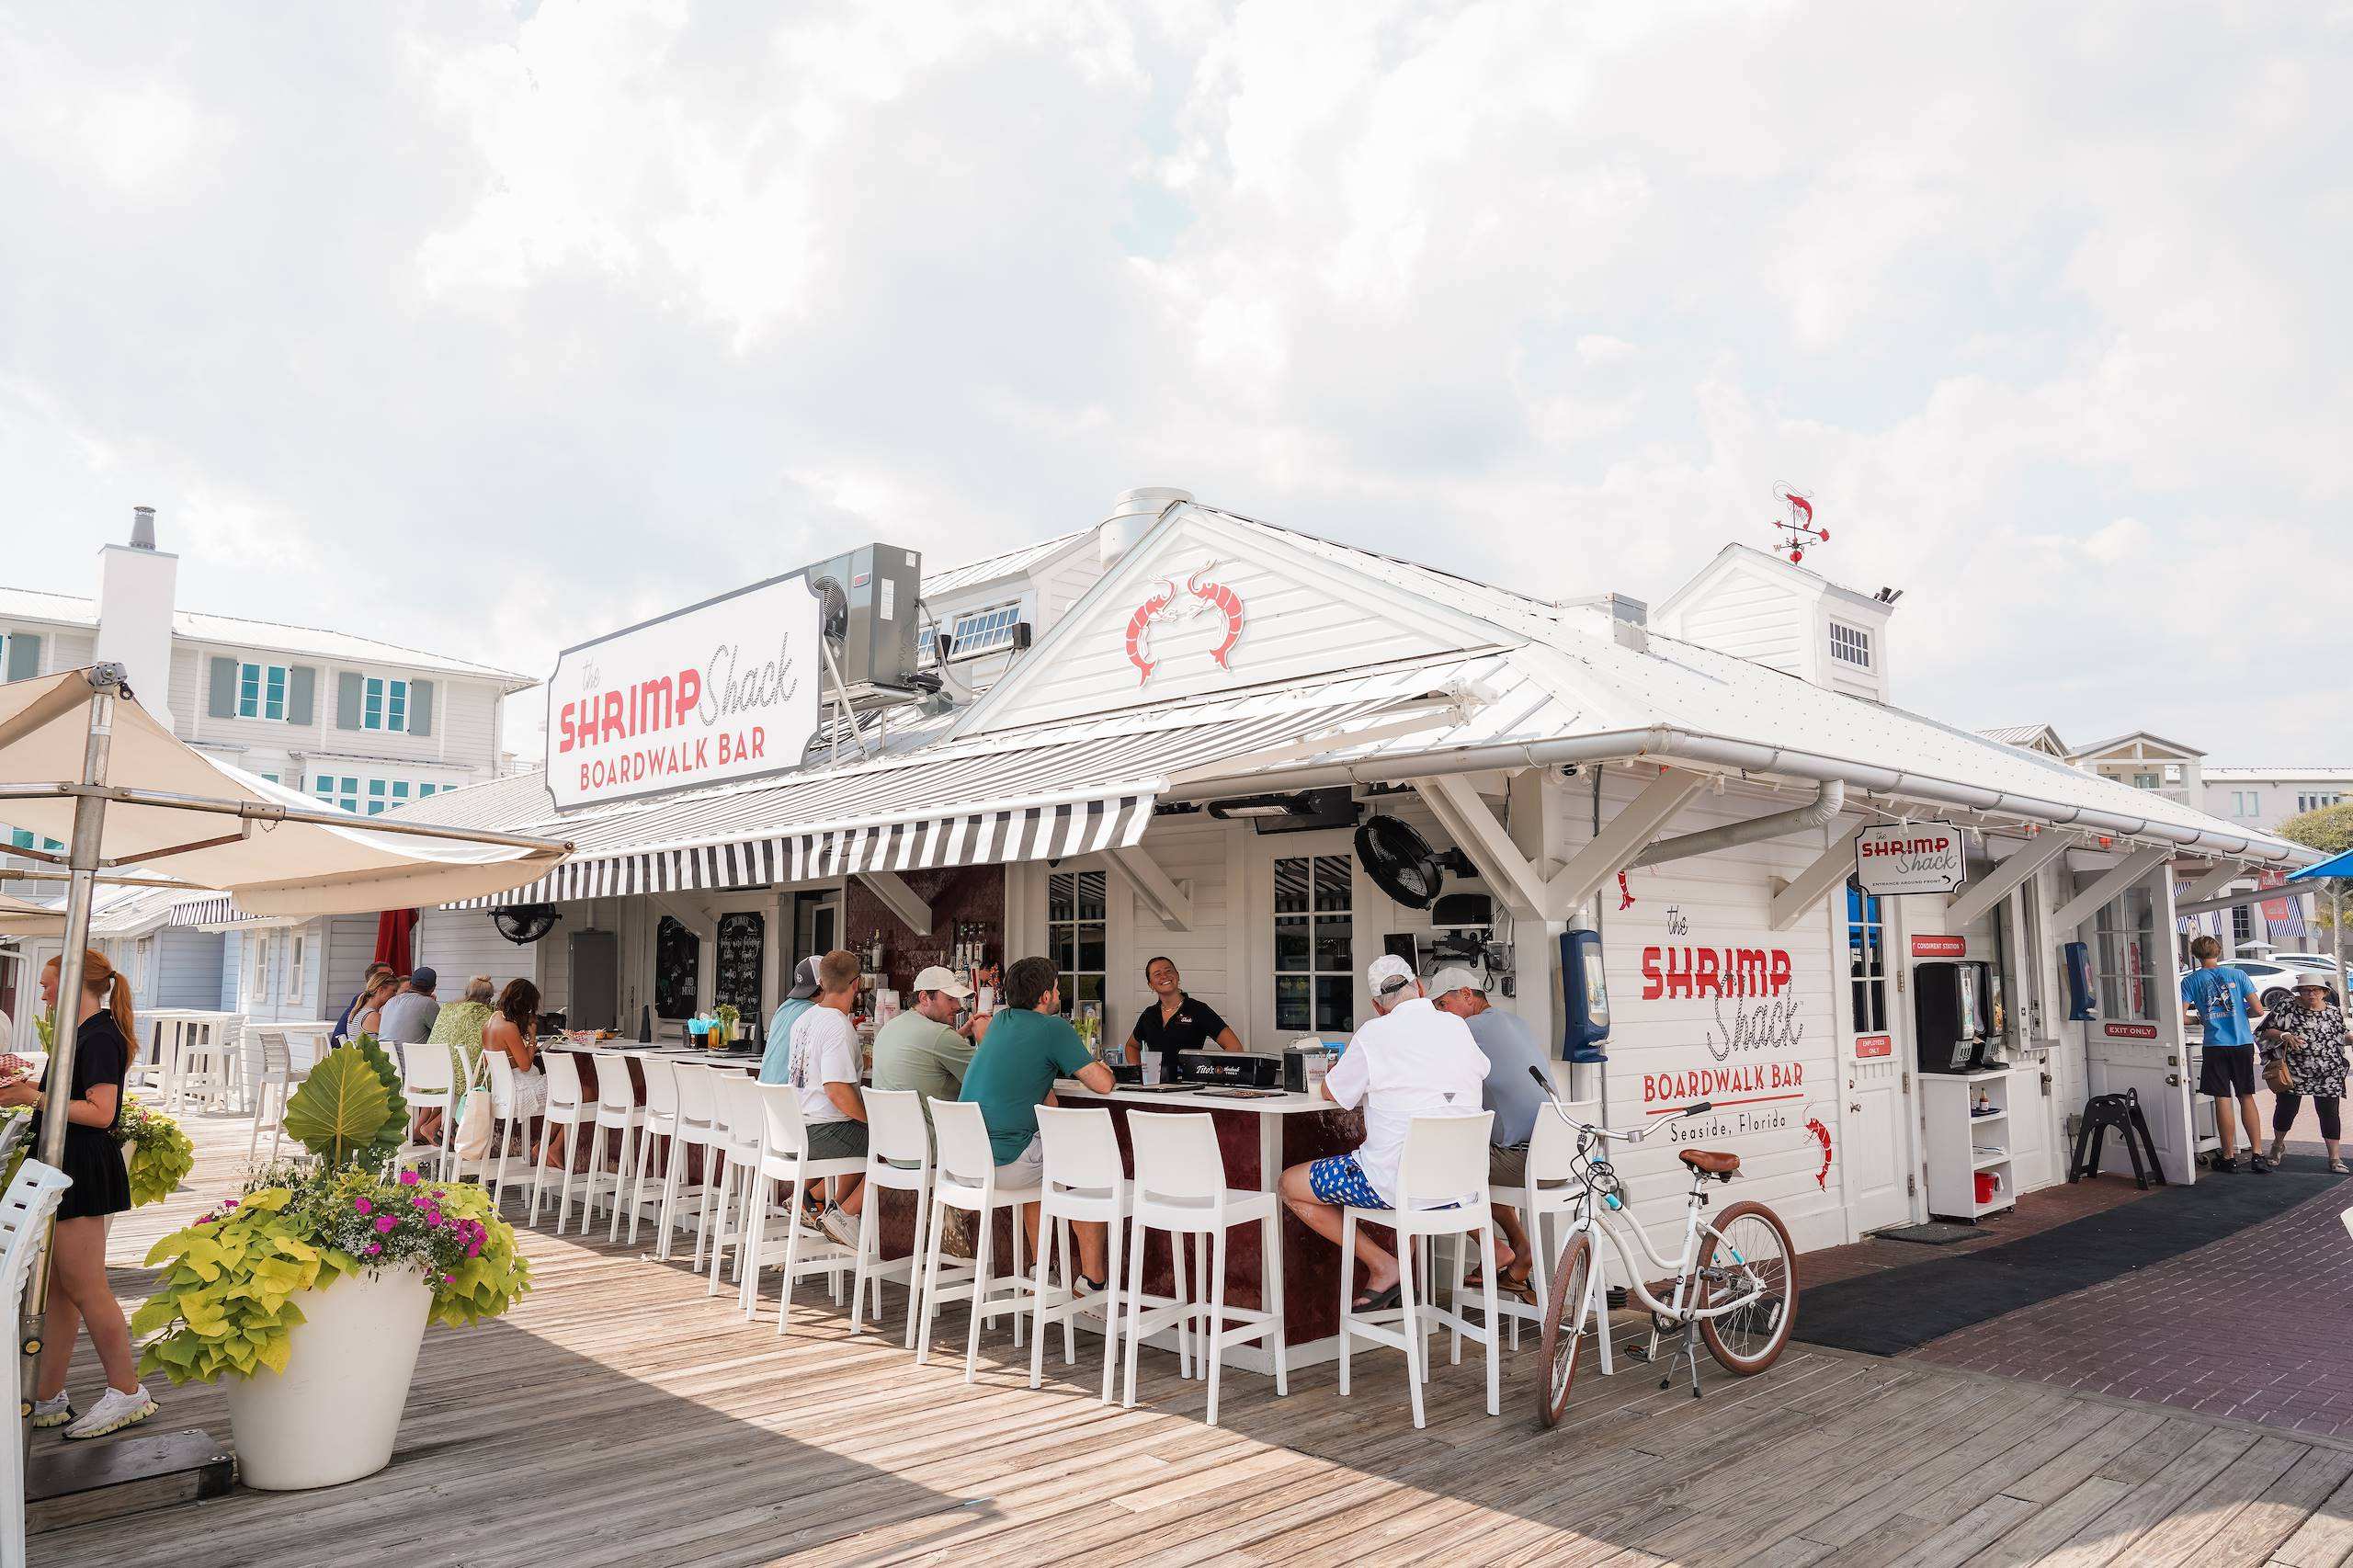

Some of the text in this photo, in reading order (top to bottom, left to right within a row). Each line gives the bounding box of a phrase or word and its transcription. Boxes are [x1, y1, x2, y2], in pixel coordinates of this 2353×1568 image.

[582, 655, 601, 691] the
[559, 631, 798, 754] SHRIMP Shack
[580, 726, 766, 791] BOARDWALK BAR
[1861, 837, 1949, 858] SHRIMP
[1895, 848, 1957, 874] Shack
[1666, 904, 1689, 936] the
[1642, 946, 1792, 1000] SHRIMP
[1707, 972, 1804, 1062] Shack
[1195, 1064, 1215, 1074] Tito's
[1643, 1062, 1803, 1103] BOARDWALK BAR
[1670, 1108, 1786, 1142] Seaside, Florida
